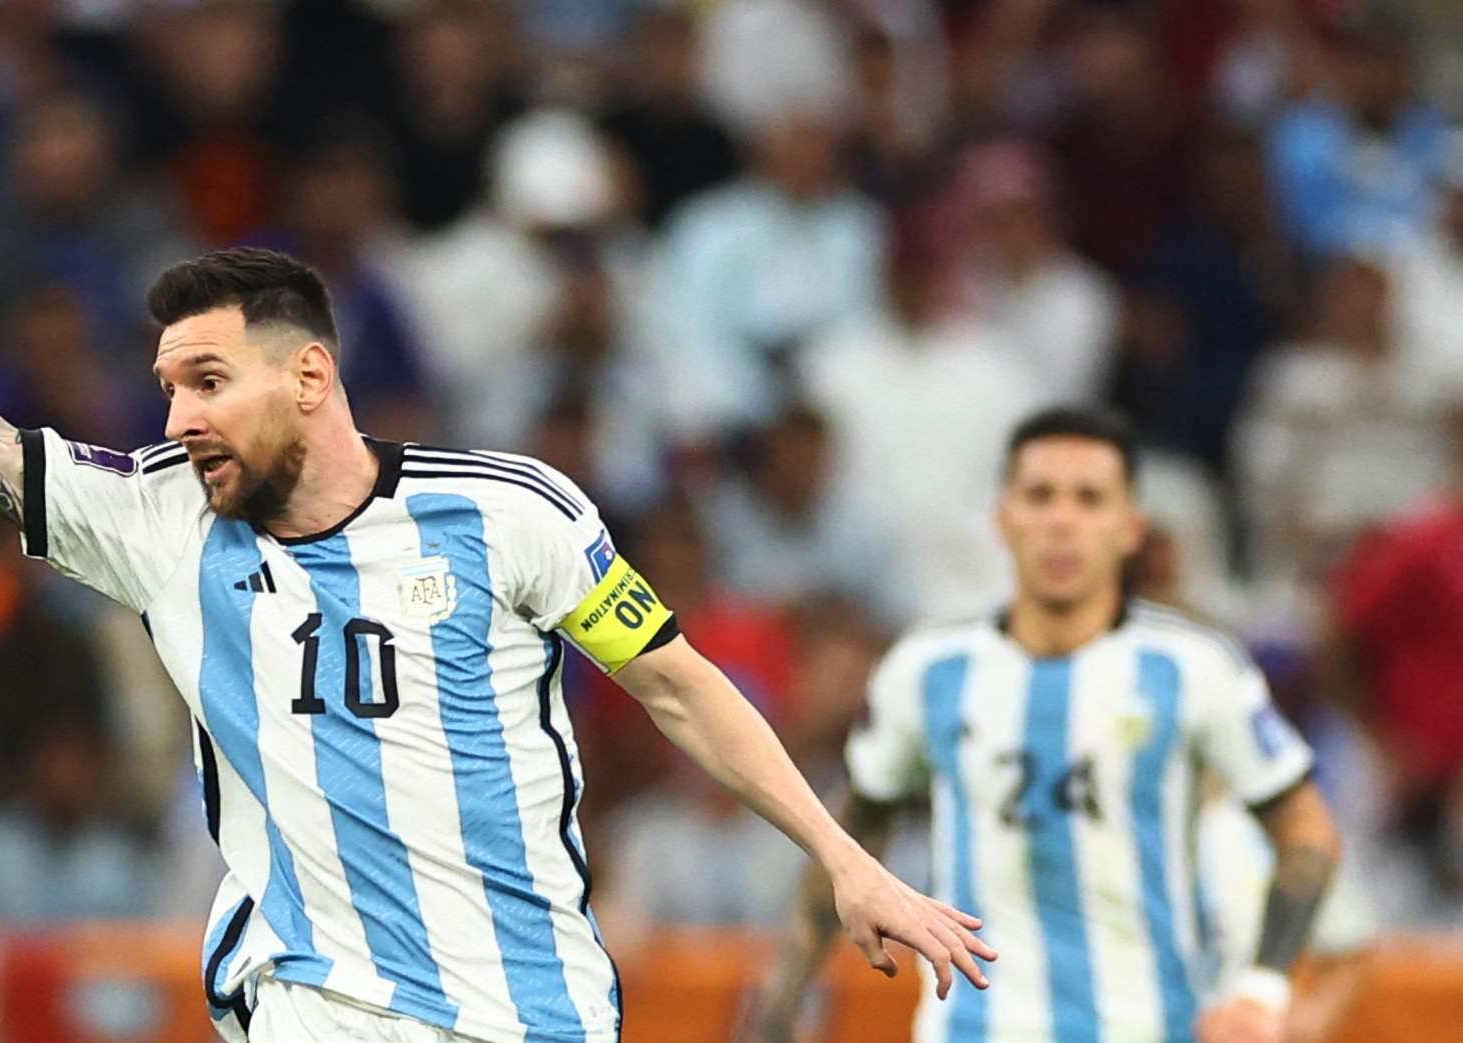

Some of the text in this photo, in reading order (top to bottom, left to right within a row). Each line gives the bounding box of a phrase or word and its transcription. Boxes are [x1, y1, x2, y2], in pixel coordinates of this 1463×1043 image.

[410, 575, 442, 605] AFA
[615, 581, 657, 630] NO
[291, 613, 400, 719] 10
[993, 752, 1103, 833] 24
